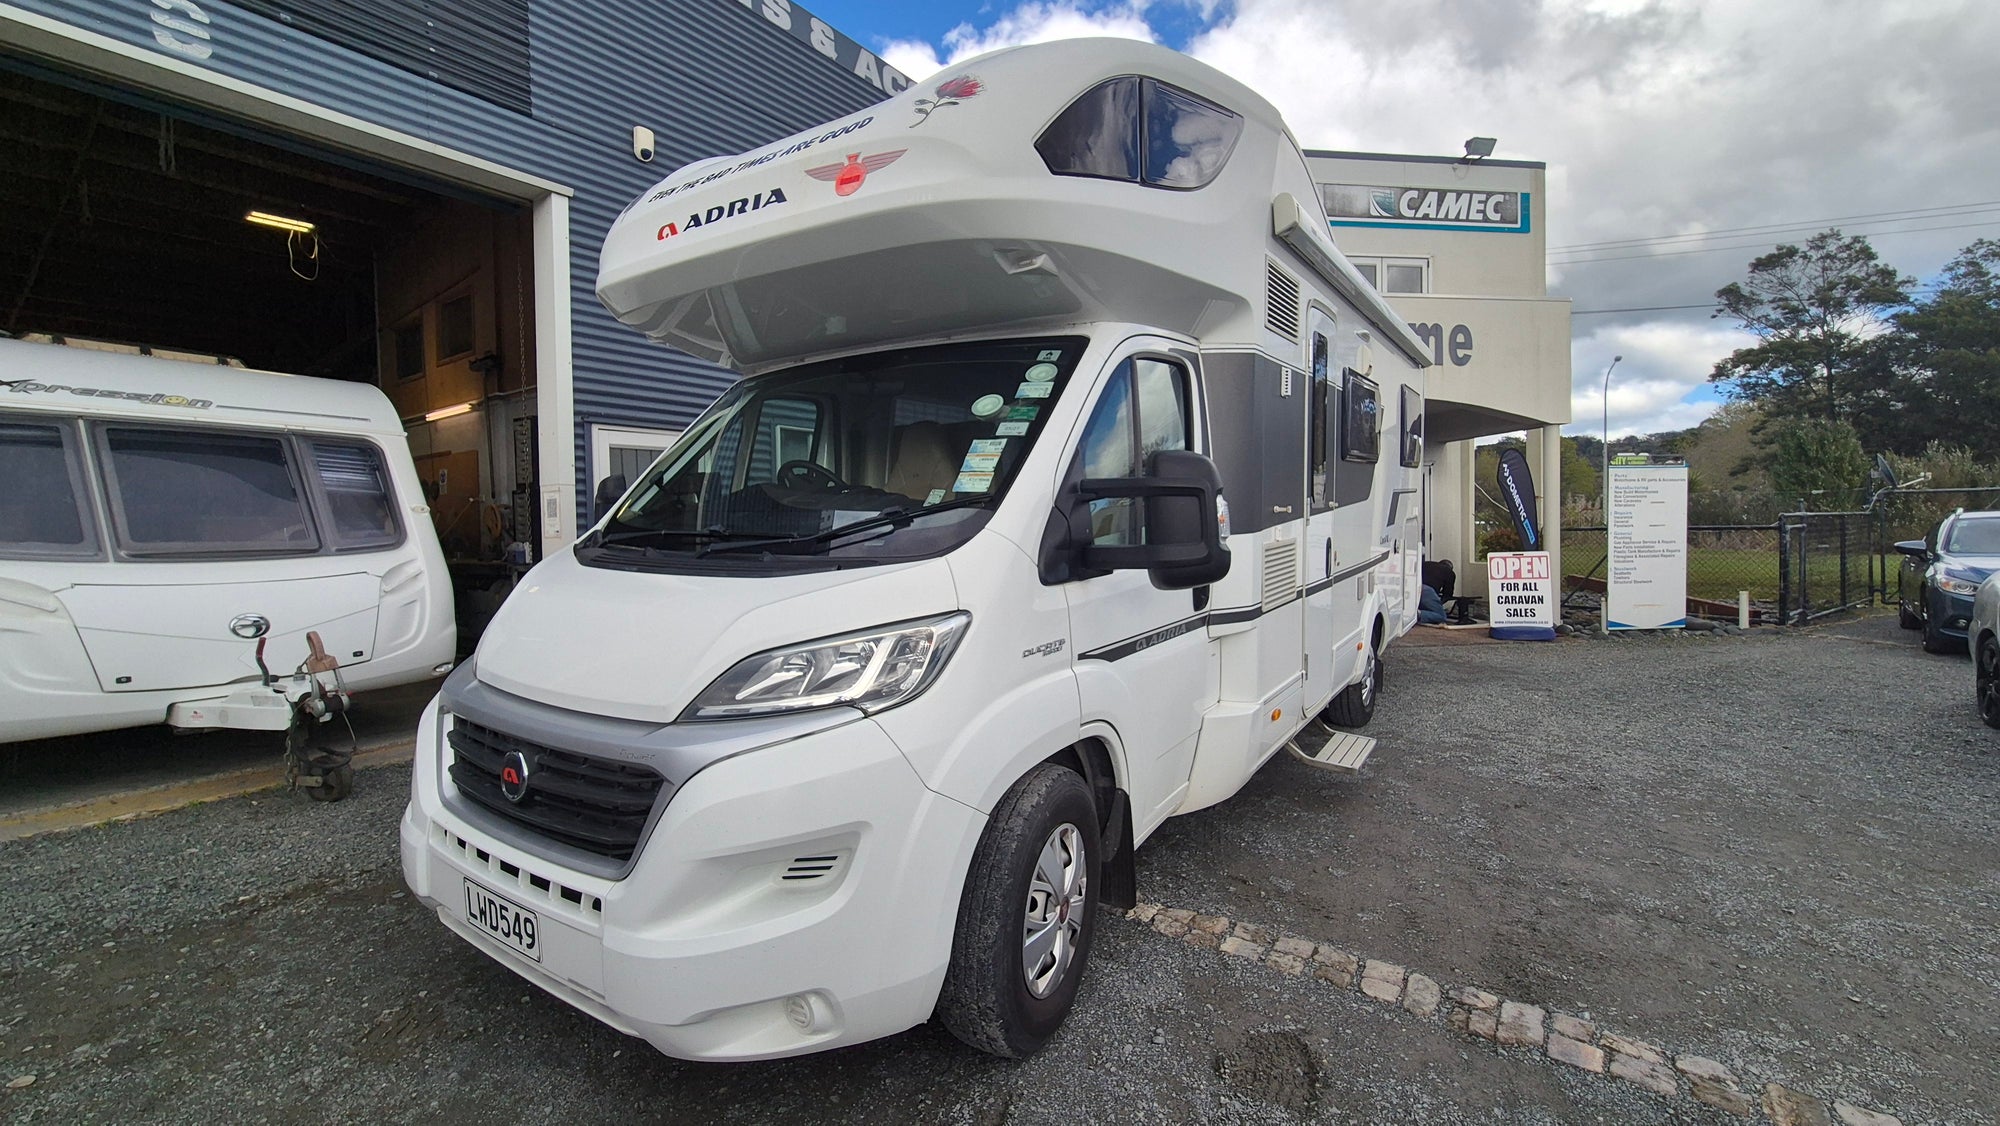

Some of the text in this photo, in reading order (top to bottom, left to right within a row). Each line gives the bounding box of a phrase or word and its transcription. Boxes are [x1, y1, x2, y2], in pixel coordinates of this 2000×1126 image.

[810, 17, 838, 61] &
[700, 167, 732, 185] BAD
[731, 150, 781, 175] TIMES
[779, 136, 821, 157] ARE
[818, 116, 875, 144] GOOD
[683, 187, 788, 233] ADRIA
[1399, 190, 1504, 221] CAMEC
[1506, 475, 1528, 522] DOMETIC
[1491, 557, 1549, 579] OPEN
[1497, 595, 1544, 605] CARAVAN
[1501, 582, 1538, 591] FOR ALL
[1506, 608, 1536, 617] SALES
[1149, 623, 1187, 647] ADRIA
[467, 886, 536, 950] LWD549
